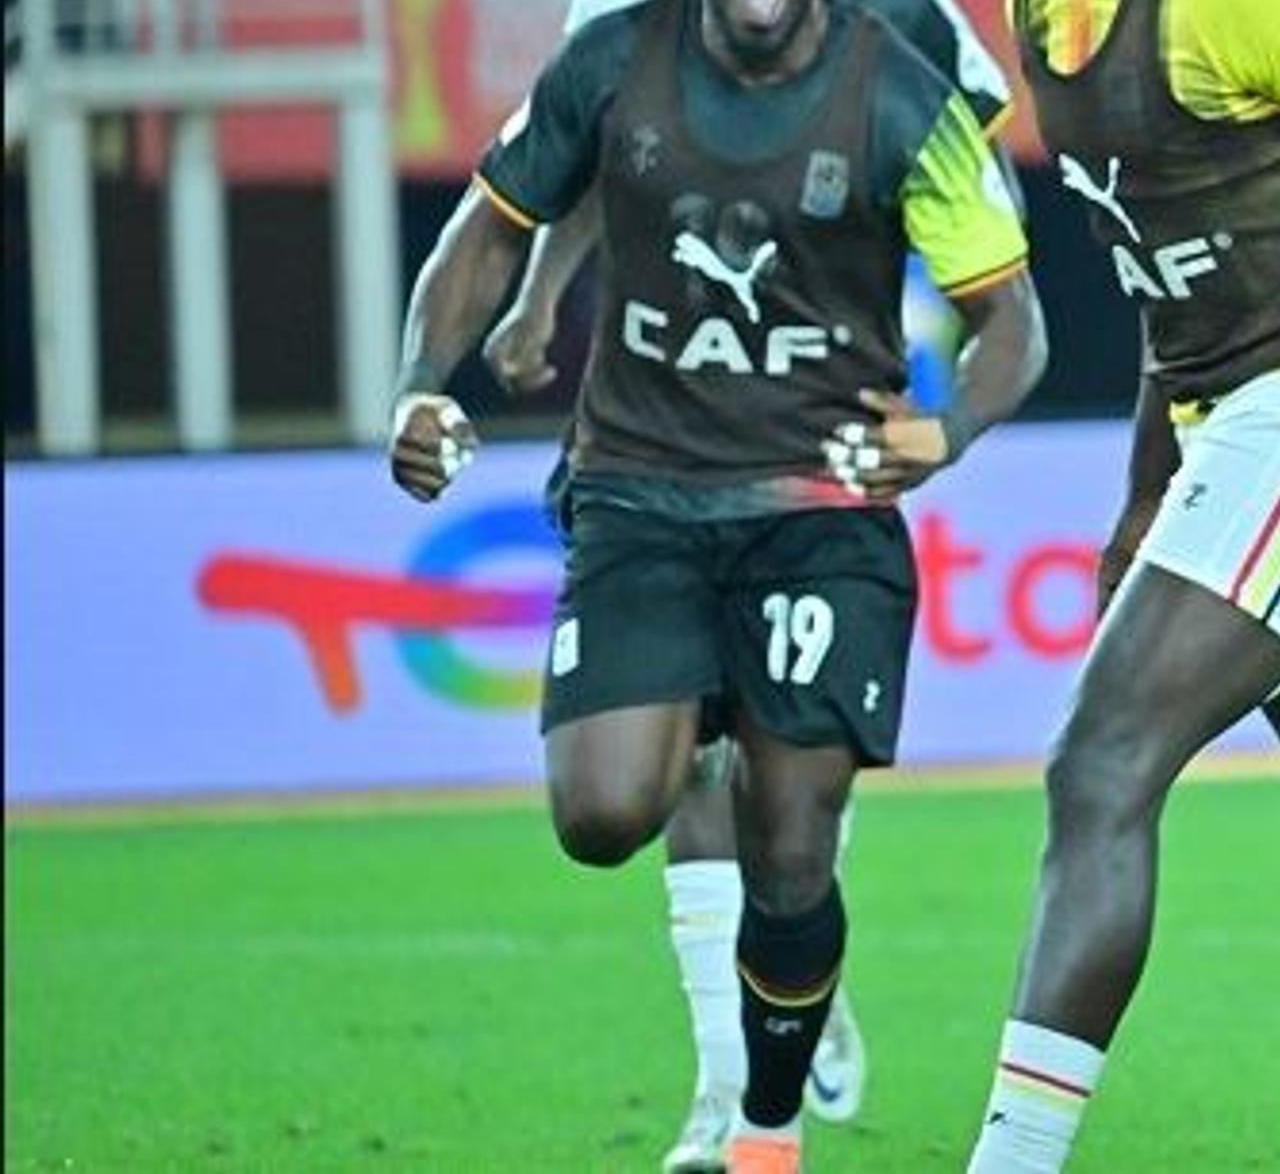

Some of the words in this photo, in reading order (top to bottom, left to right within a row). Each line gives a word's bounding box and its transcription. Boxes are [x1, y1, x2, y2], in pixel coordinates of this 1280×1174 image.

[1112, 237, 1218, 300] AF
[623, 299, 830, 375] CAF
[762, 592, 834, 685] 19
